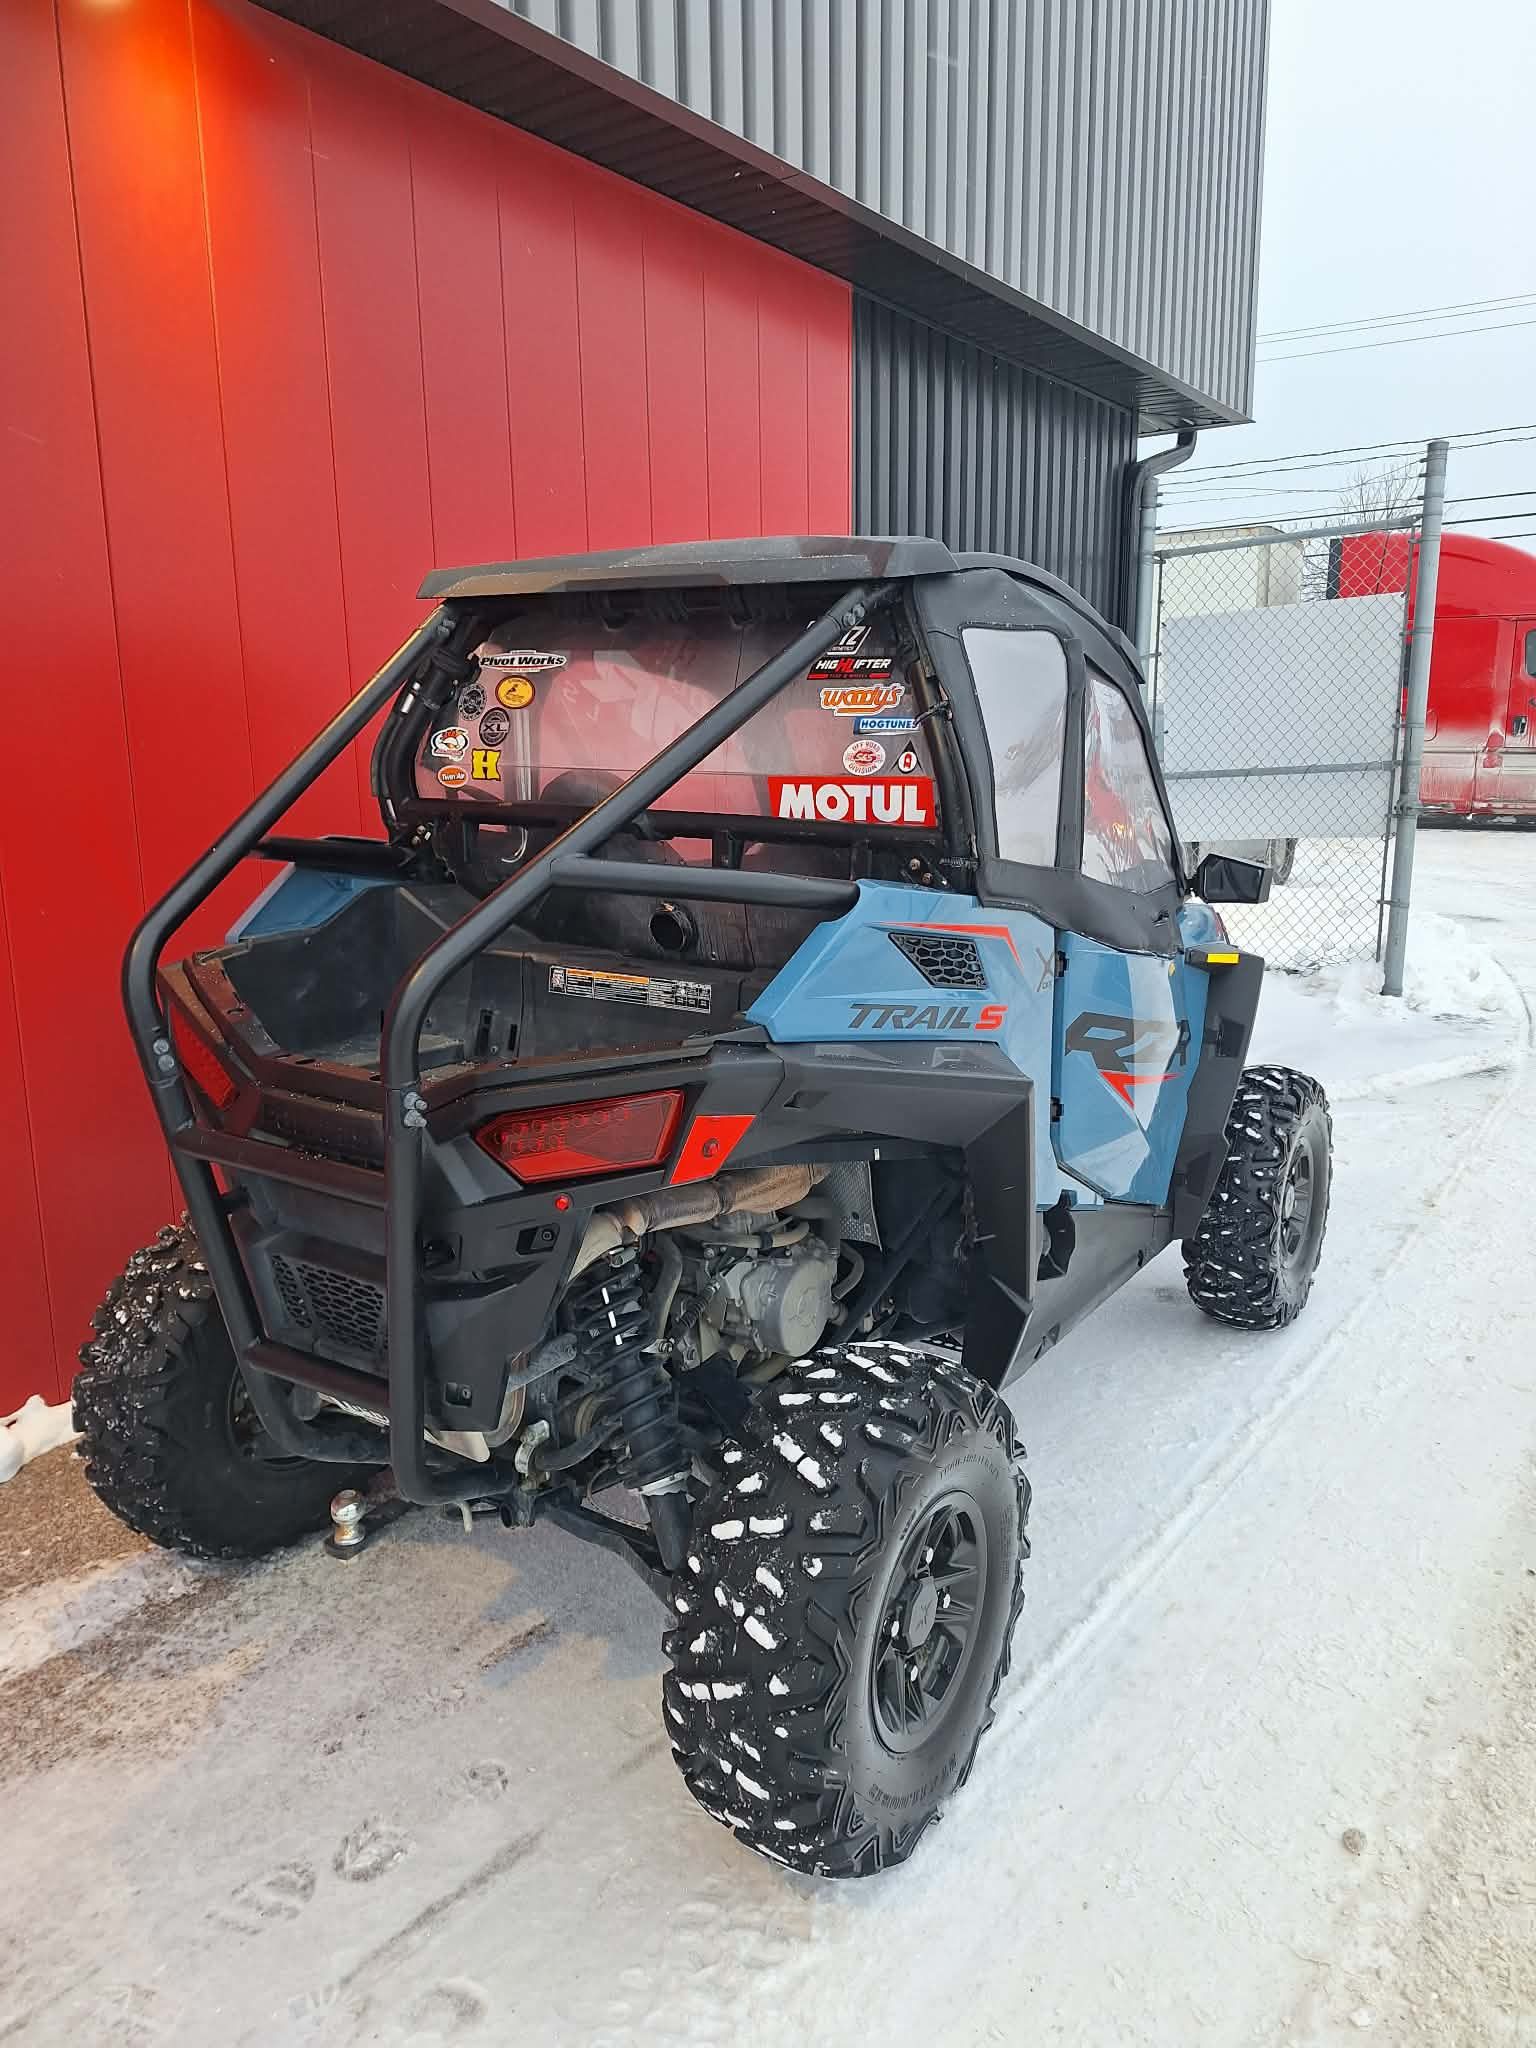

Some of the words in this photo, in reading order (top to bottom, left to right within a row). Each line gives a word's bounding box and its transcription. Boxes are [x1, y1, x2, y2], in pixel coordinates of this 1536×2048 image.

[480, 656, 515, 666] Pivot
[517, 656, 564, 665] Works
[483, 723, 507, 732] XL
[472, 748, 501, 781] H
[848, 763, 877, 774] DIVISION
[779, 783, 926, 823] MOTUL
